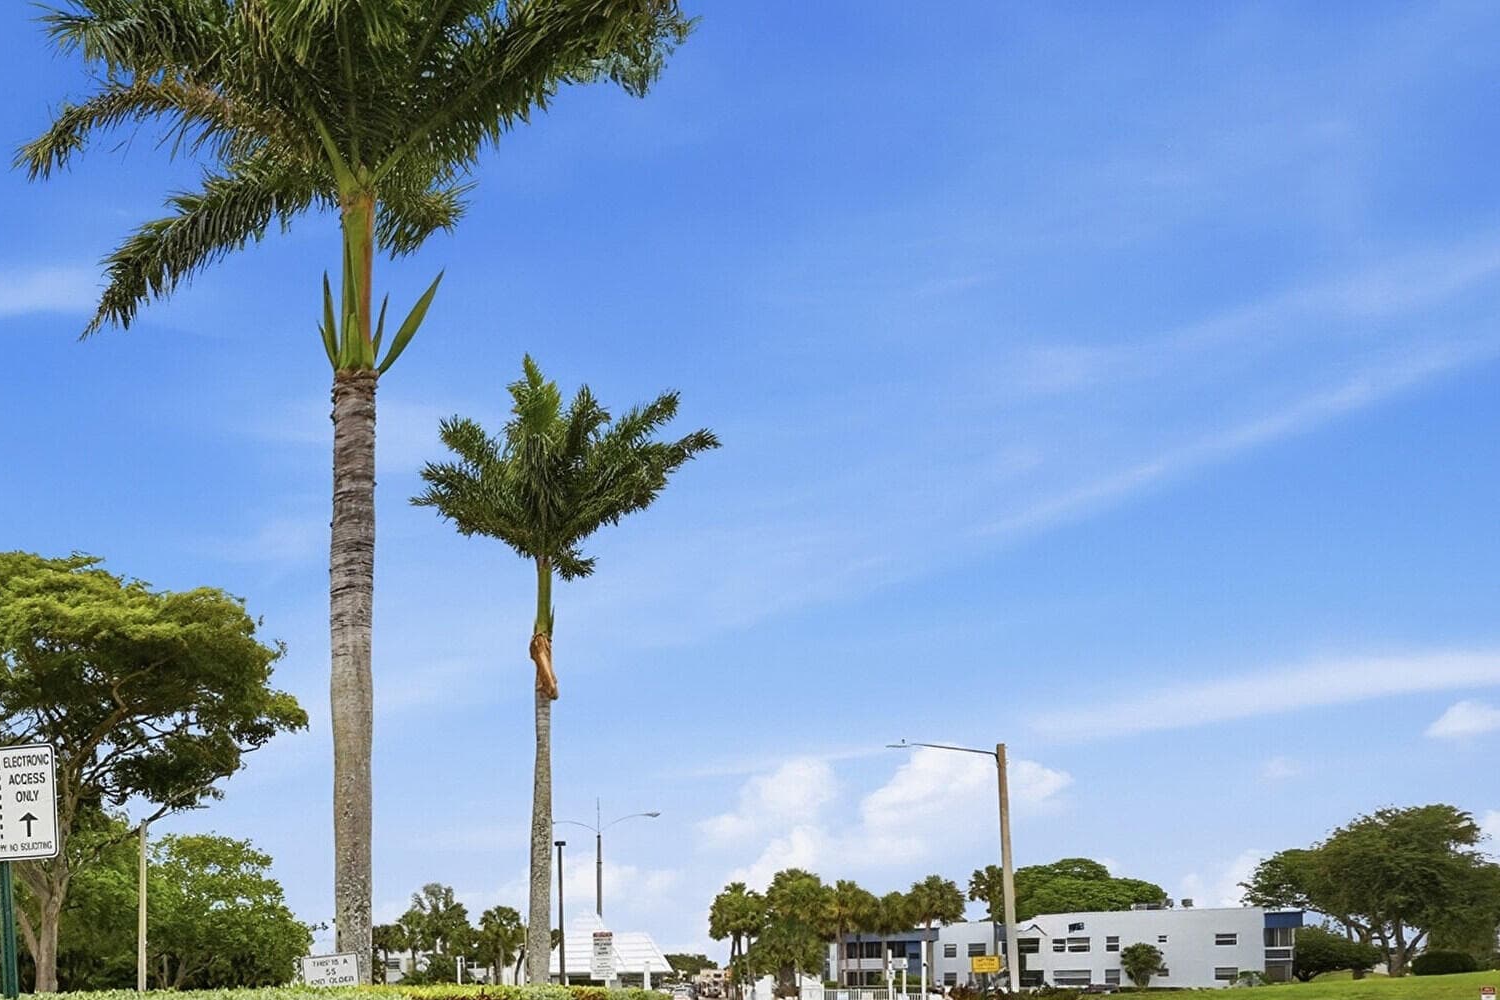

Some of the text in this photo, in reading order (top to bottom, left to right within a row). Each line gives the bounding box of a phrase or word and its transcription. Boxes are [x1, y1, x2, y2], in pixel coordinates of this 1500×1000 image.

[3, 754, 49, 768] ELECTRONIC
[9, 772, 45, 785] ACCESS
[16, 790, 39, 802] ONLY
[9, 843, 19, 852] NO
[20, 840, 53, 851] SOLICITING
